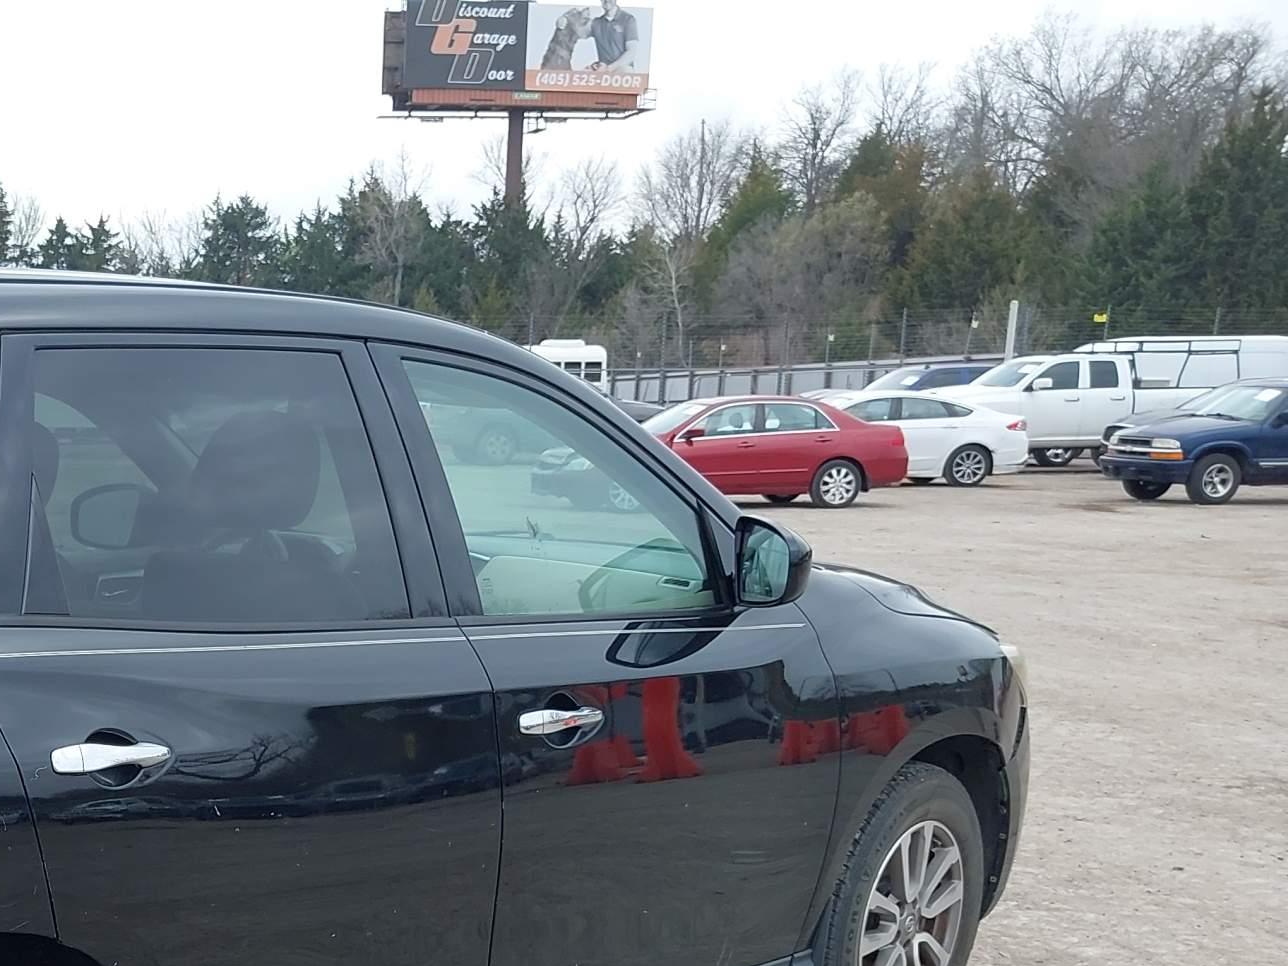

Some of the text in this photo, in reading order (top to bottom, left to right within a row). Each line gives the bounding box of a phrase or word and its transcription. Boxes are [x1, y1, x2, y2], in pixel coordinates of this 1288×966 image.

[415, 0, 515, 26] Discount
[430, 18, 517, 54] Garage
[448, 48, 514, 84] Door
[535, 72, 641, 88] (405) 525-DOOR
